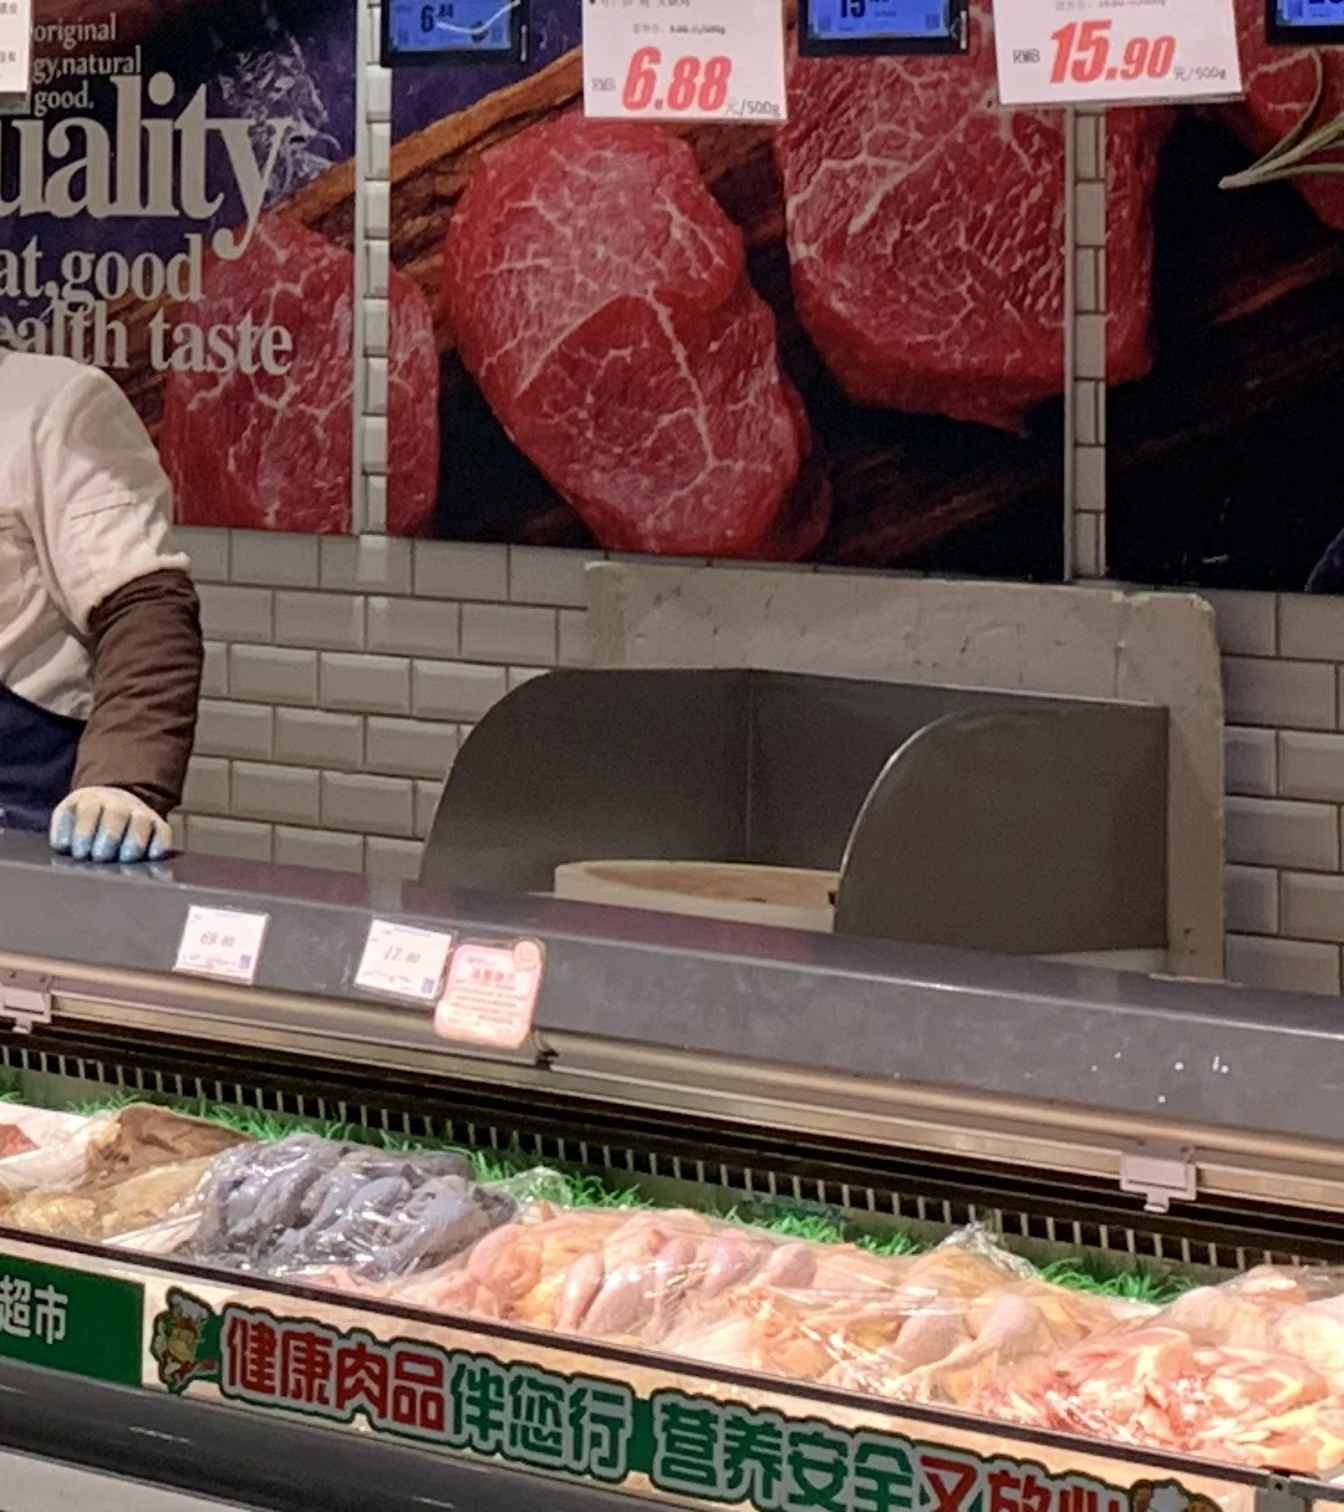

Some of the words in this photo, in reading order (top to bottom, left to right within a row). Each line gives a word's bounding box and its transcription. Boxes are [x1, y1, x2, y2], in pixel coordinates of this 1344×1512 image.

[32, 44, 142, 85] gy,natural
[622, 45, 733, 112] 6.88
[1048, 19, 1177, 85] 15.90
[149, 304, 295, 376] taste
[226, 1314, 629, 1478] 健康肉品伴您行
